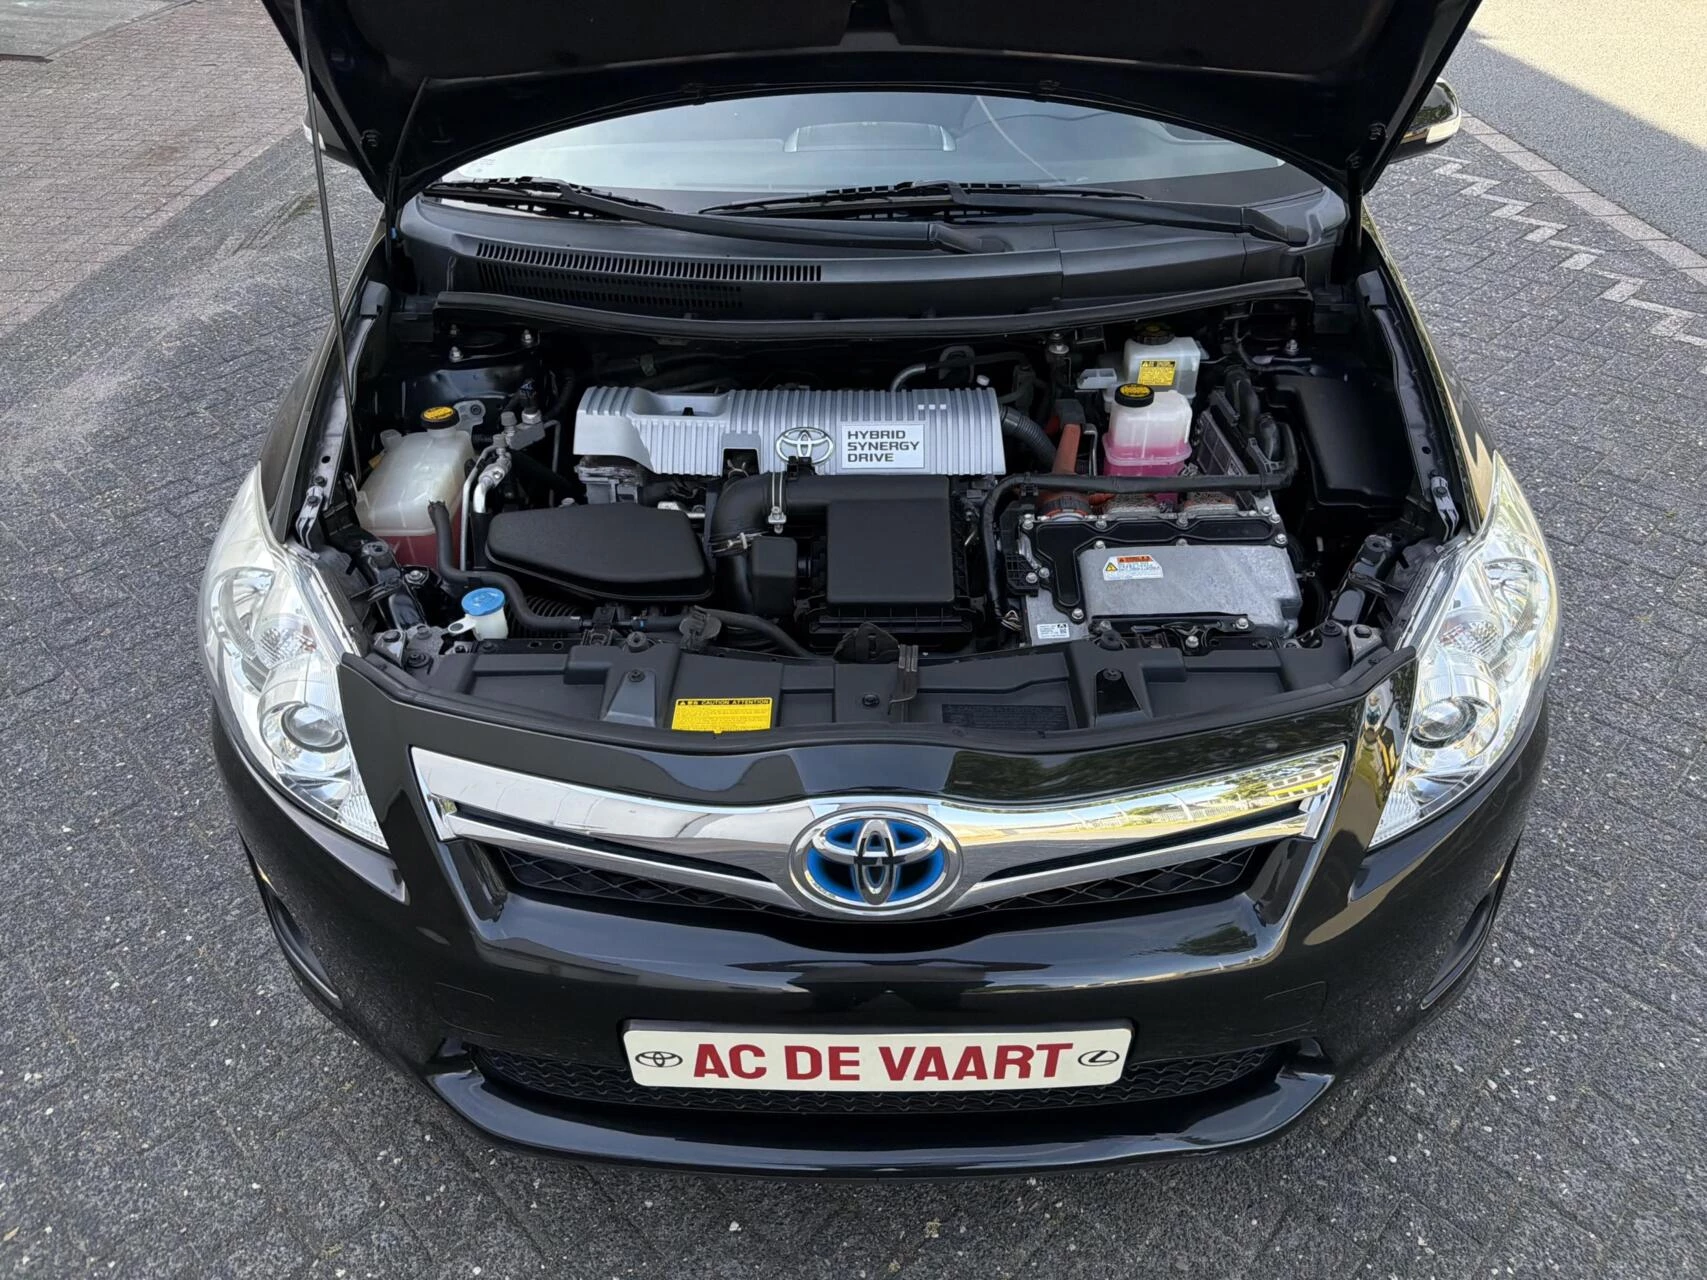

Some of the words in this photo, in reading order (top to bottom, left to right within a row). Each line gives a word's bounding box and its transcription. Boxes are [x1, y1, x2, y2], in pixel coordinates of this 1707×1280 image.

[847, 430, 906, 440] HYBRID
[847, 441, 920, 451] SYNERGY
[847, 453, 894, 463] DRIVE
[693, 1043, 767, 1078] AC
[784, 1045, 861, 1081] DE
[878, 1042, 1074, 1081] VAART
